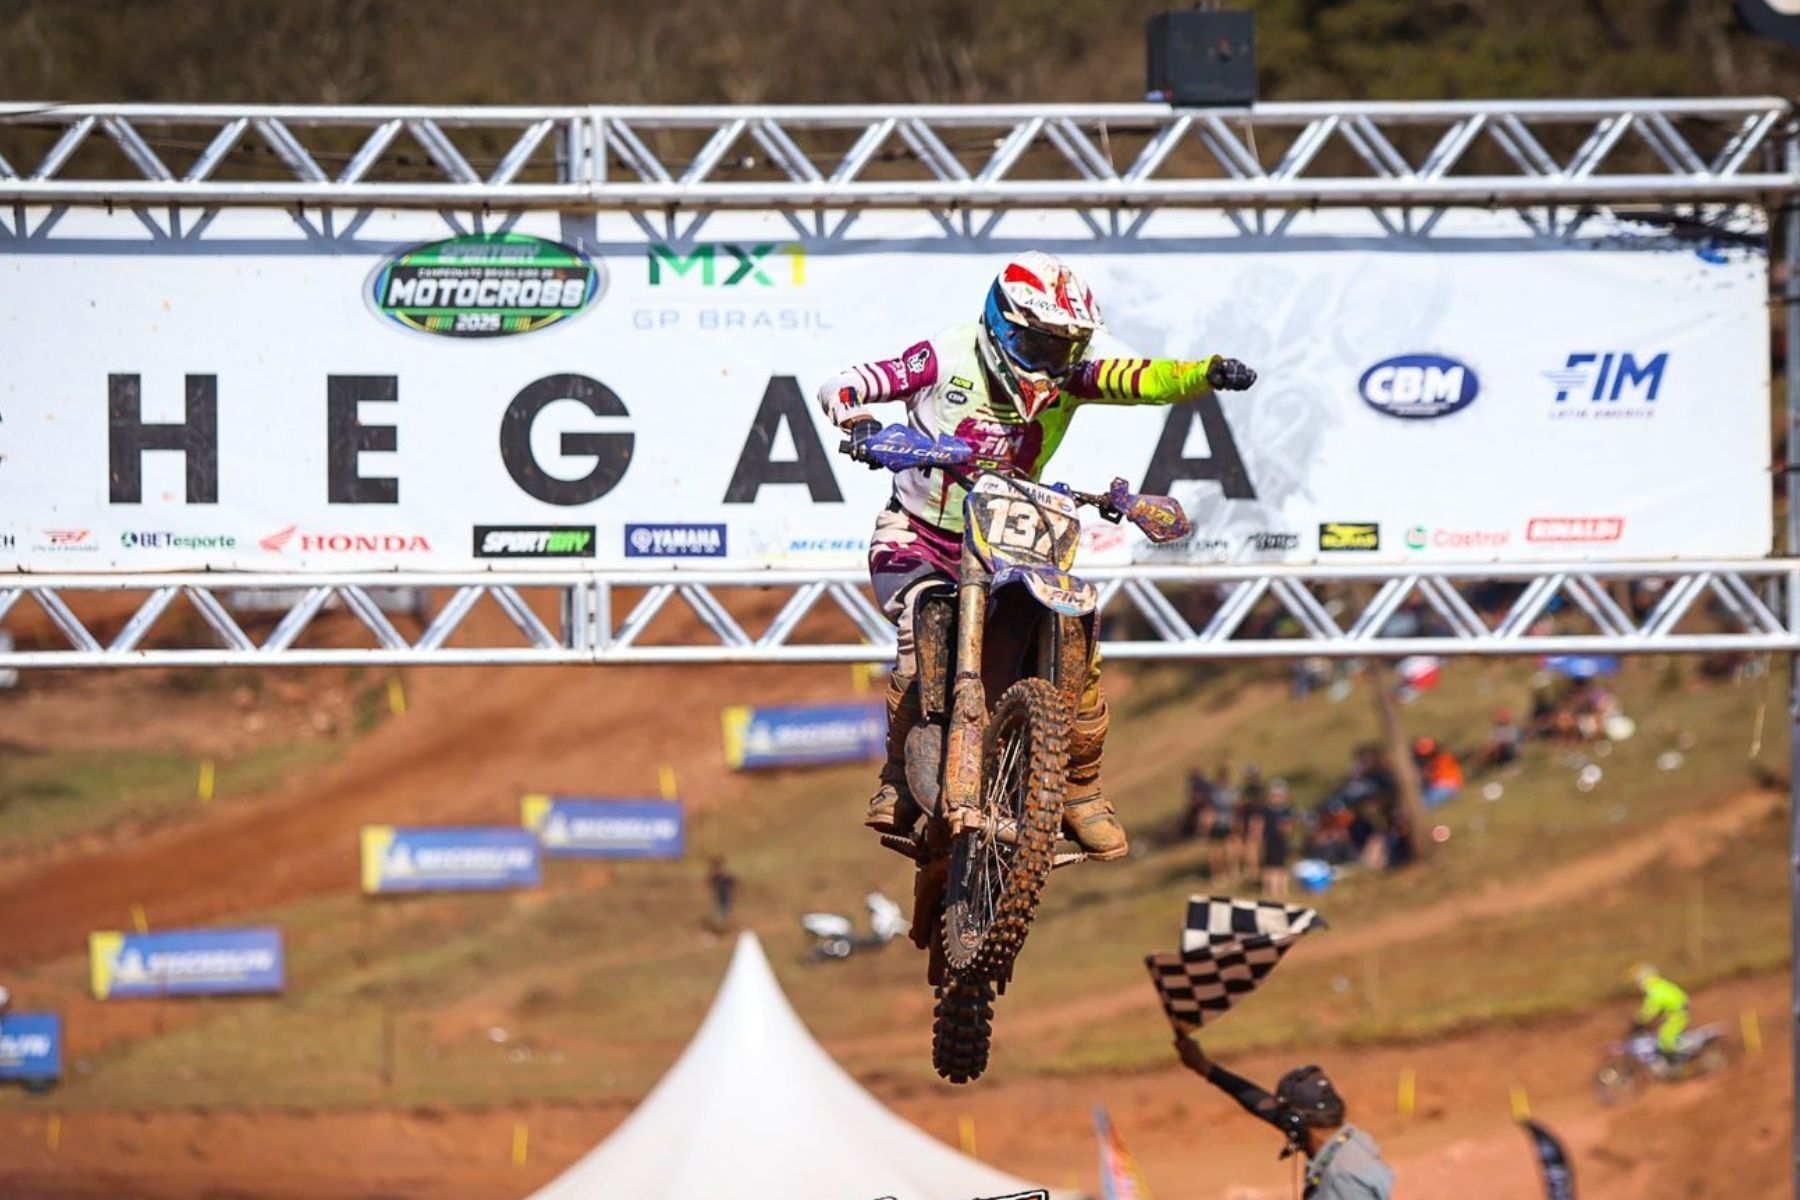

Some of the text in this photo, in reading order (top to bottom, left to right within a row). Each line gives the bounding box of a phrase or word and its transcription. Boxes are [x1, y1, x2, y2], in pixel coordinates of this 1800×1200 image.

[648, 243, 806, 287] MX1
[387, 278, 586, 307] MOTOCROSS
[455, 313, 501, 331] 2025
[632, 309, 833, 330] GP BRASIL
[1364, 366, 1465, 404] CBM
[1550, 353, 1669, 402] FIM
[140, 531, 236, 550] BETesporte
[301, 535, 432, 551] HONDA
[652, 528, 721, 548] YAMAHA
[1433, 529, 1510, 548] Castrol
